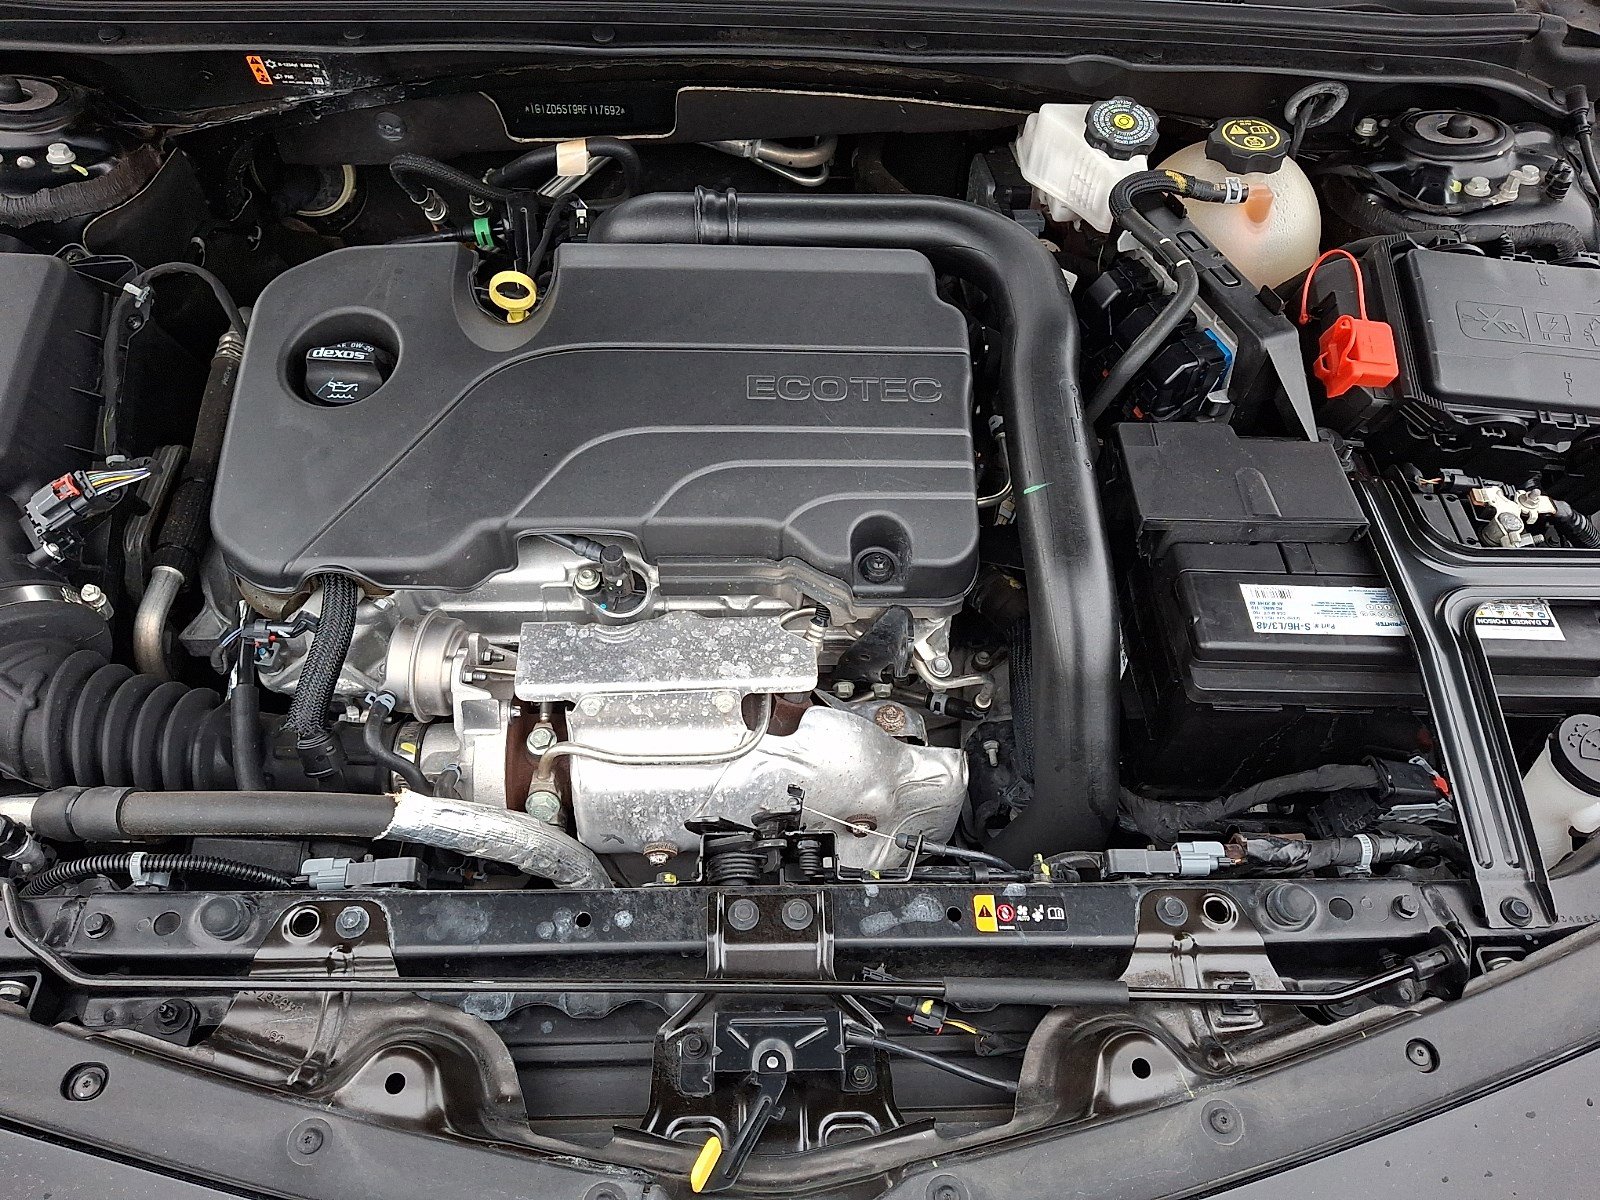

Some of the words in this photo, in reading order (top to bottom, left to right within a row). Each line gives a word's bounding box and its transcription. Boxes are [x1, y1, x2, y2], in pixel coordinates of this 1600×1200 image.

[312, 347, 364, 359] dexos
[746, 374, 943, 403] ECOTEC
[1256, 620, 1311, 631] S-H6/L3/48
